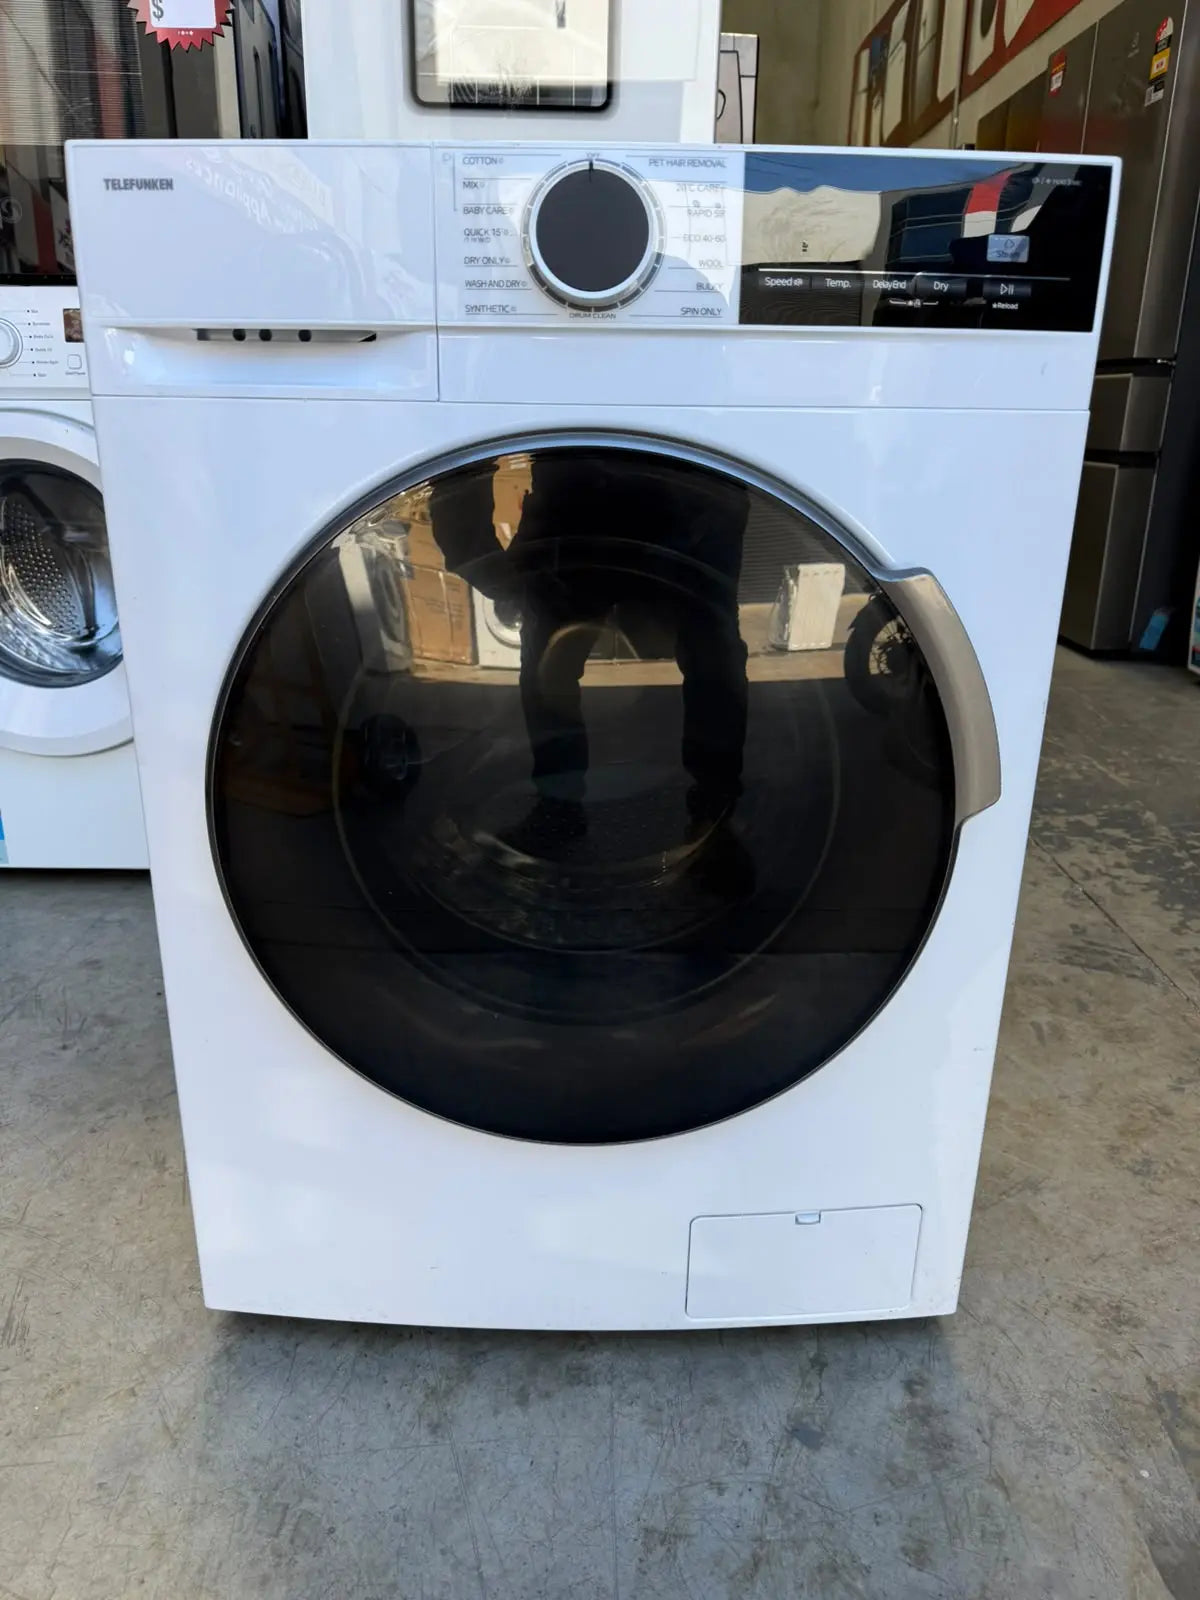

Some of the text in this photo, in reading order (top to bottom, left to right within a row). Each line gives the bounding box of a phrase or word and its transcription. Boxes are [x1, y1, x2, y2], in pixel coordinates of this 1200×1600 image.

[152, 0, 164, 21] $
[462, 156, 498, 165] COTTON
[649, 158, 727, 168] PET HAIR REMOVAL
[103, 177, 174, 191] TELEFUNKEN
[462, 181, 479, 190] MIX
[463, 206, 507, 215] BABY CARE
[463, 227, 490, 238] QUICK
[683, 233, 701, 242] ECO
[463, 256, 504, 265] DRY ONLY
[699, 259, 723, 268] WOOL
[465, 279, 521, 288] WASH AND DRY
[765, 276, 792, 288] Speed
[825, 278, 852, 289] Temp.
[933, 280, 949, 293] Dry
[465, 304, 510, 314] SYNTHETIC
[997, 302, 1019, 311] Reload
[592, 312, 617, 320] CLEAN
[680, 307, 722, 316] SPIN ONLY
